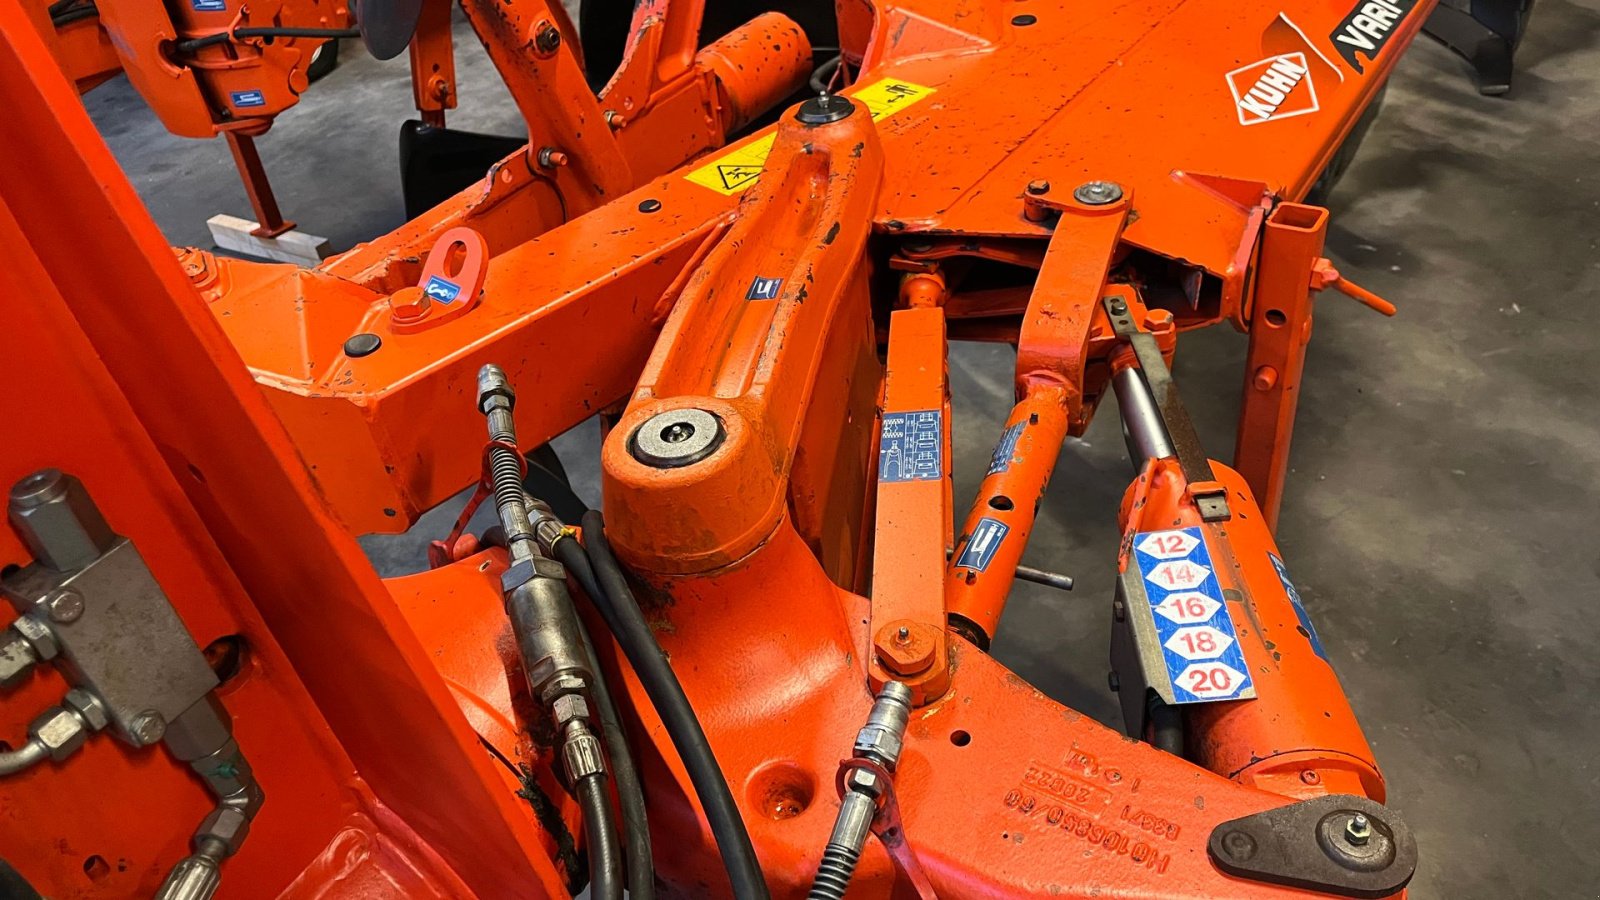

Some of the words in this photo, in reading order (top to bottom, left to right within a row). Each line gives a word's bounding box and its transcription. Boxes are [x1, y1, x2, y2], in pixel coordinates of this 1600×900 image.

[1238, 57, 1307, 119] KUHN
[1152, 535, 1187, 554] 12
[1162, 564, 1196, 585] 14
[1170, 597, 1206, 619] 16
[1180, 631, 1217, 654] 18
[1189, 667, 1232, 693] 20
